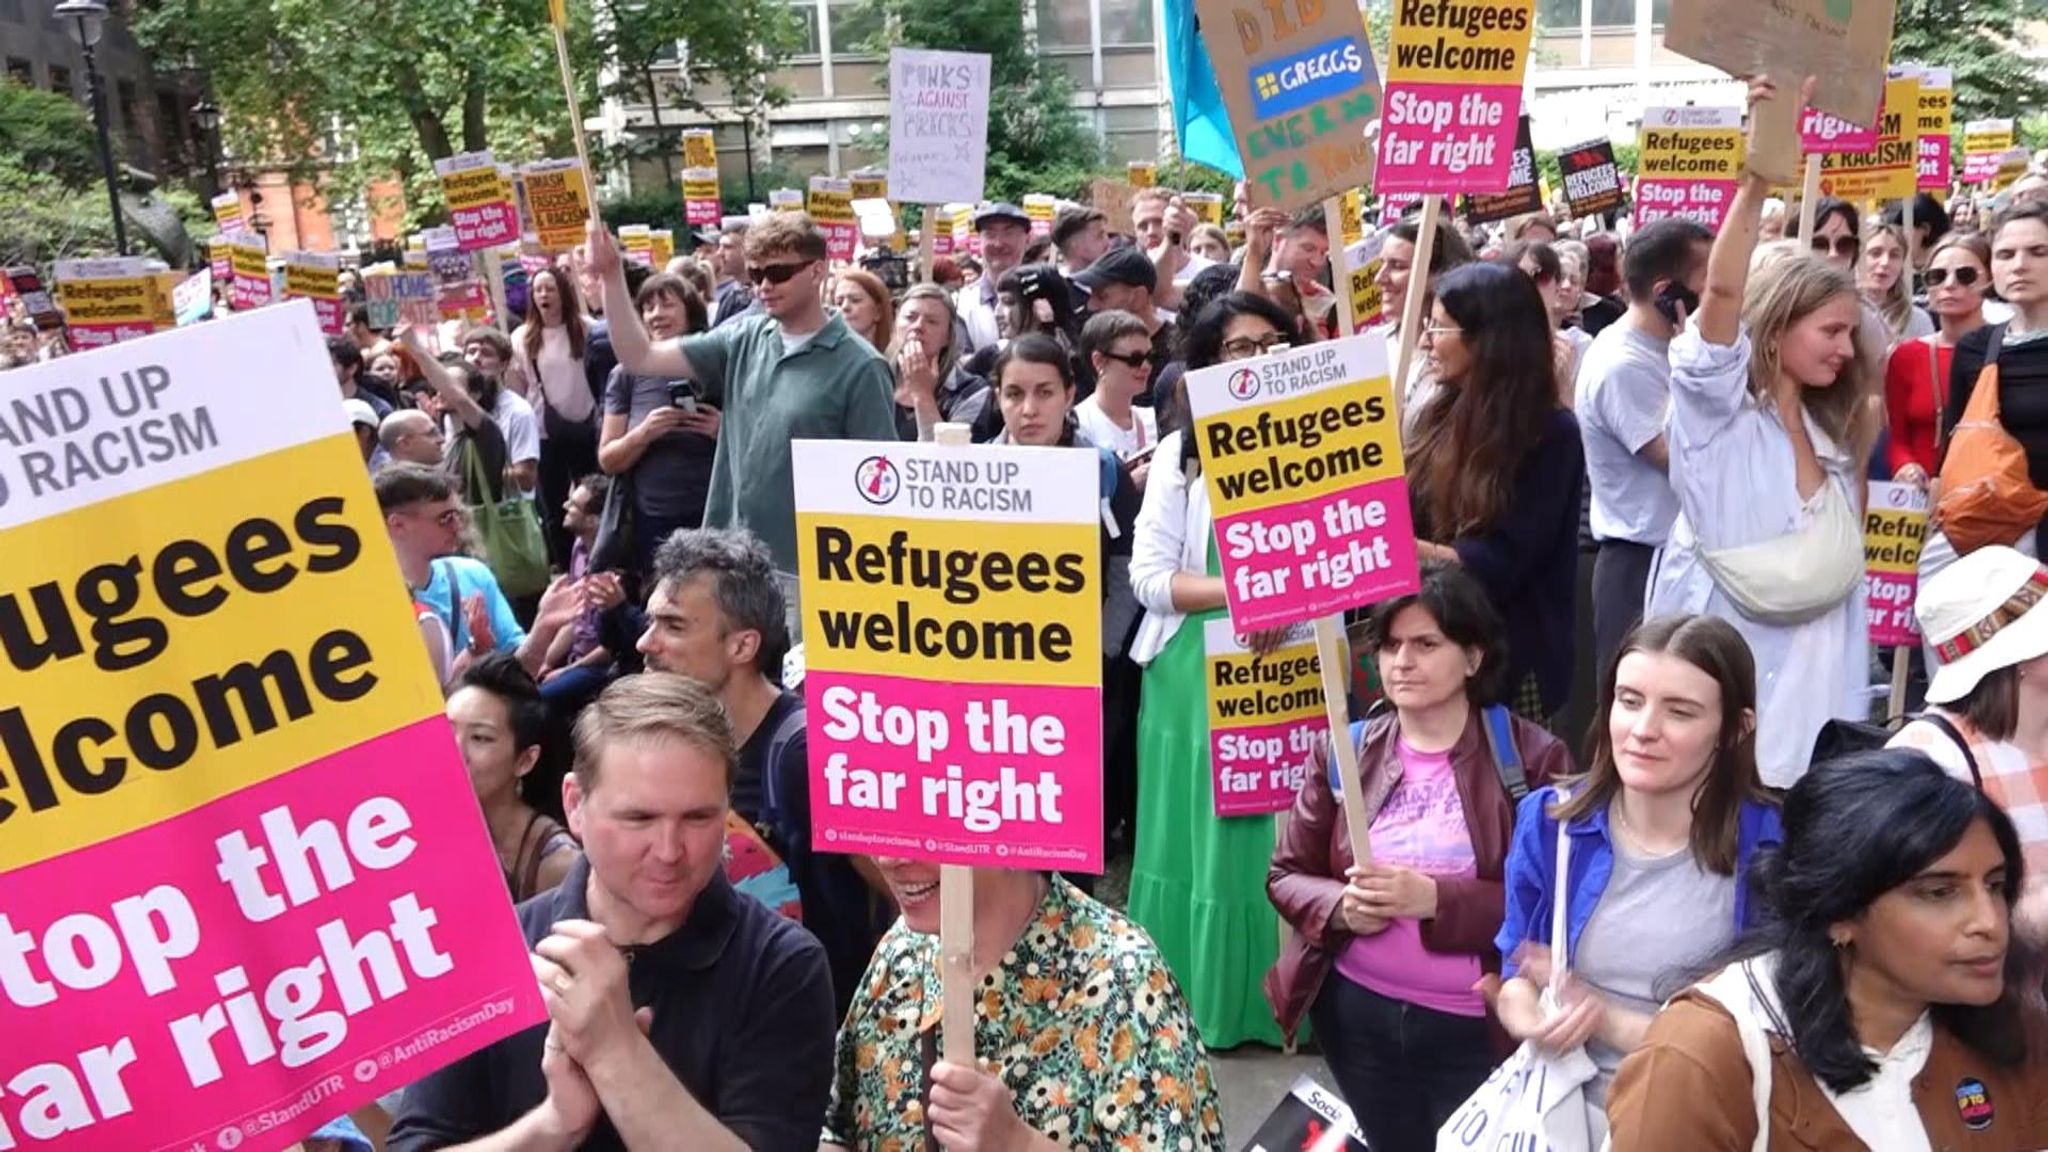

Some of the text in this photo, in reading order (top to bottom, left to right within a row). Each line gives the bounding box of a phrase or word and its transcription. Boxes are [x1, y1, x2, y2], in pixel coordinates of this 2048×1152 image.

[1400, 0, 1528, 38] Refugees
[1280, 44, 1362, 90] GREGGS
[1397, 37, 1515, 71] welcome
[916, 91, 969, 109] AGAINST
[1388, 90, 1502, 133] Stop the
[1246, 105, 1337, 159] EVER
[1646, 132, 1734, 154] Refugees
[1384, 132, 1424, 165] far
[1429, 132, 1496, 173] right
[1645, 155, 1728, 172] welcome
[1841, 141, 1912, 167] RACISM
[1257, 160, 1309, 200] TO
[1566, 163, 1616, 187] REFUGEES
[1568, 176, 1619, 199] WELCOME
[453, 204, 504, 226] Stop the
[1641, 184, 1686, 208] Stop
[1690, 183, 1723, 203] the
[457, 220, 508, 241] far right
[63, 283, 144, 301] Refugees
[69, 303, 143, 318] welcome
[1262, 349, 1337, 381] STAND UP
[1265, 364, 1347, 396] TO RACISM
[100, 364, 171, 418] UP
[1207, 396, 1386, 458] Refugees
[20, 405, 219, 497] RACISM
[1216, 440, 1384, 501] welcome
[905, 459, 1020, 486] STAND UP
[906, 485, 1033, 513] TO RACISM
[1225, 498, 1387, 560] Stop the
[815, 526, 1086, 604] Refugees
[1233, 565, 1291, 602] far
[1301, 536, 1392, 590] right
[818, 601, 1074, 663] welcome
[1214, 654, 1321, 687] Refugee
[0, 628, 378, 824] lcome
[821, 685, 1066, 762] Stop the
[1218, 725, 1318, 764] Stop th
[824, 752, 1064, 833] far right
[1220, 762, 1306, 793] far rig
[214, 796, 417, 922] the
[0, 892, 454, 1152] ar right
[242, 997, 516, 1137] @StandUTR @AntiRacismDay
